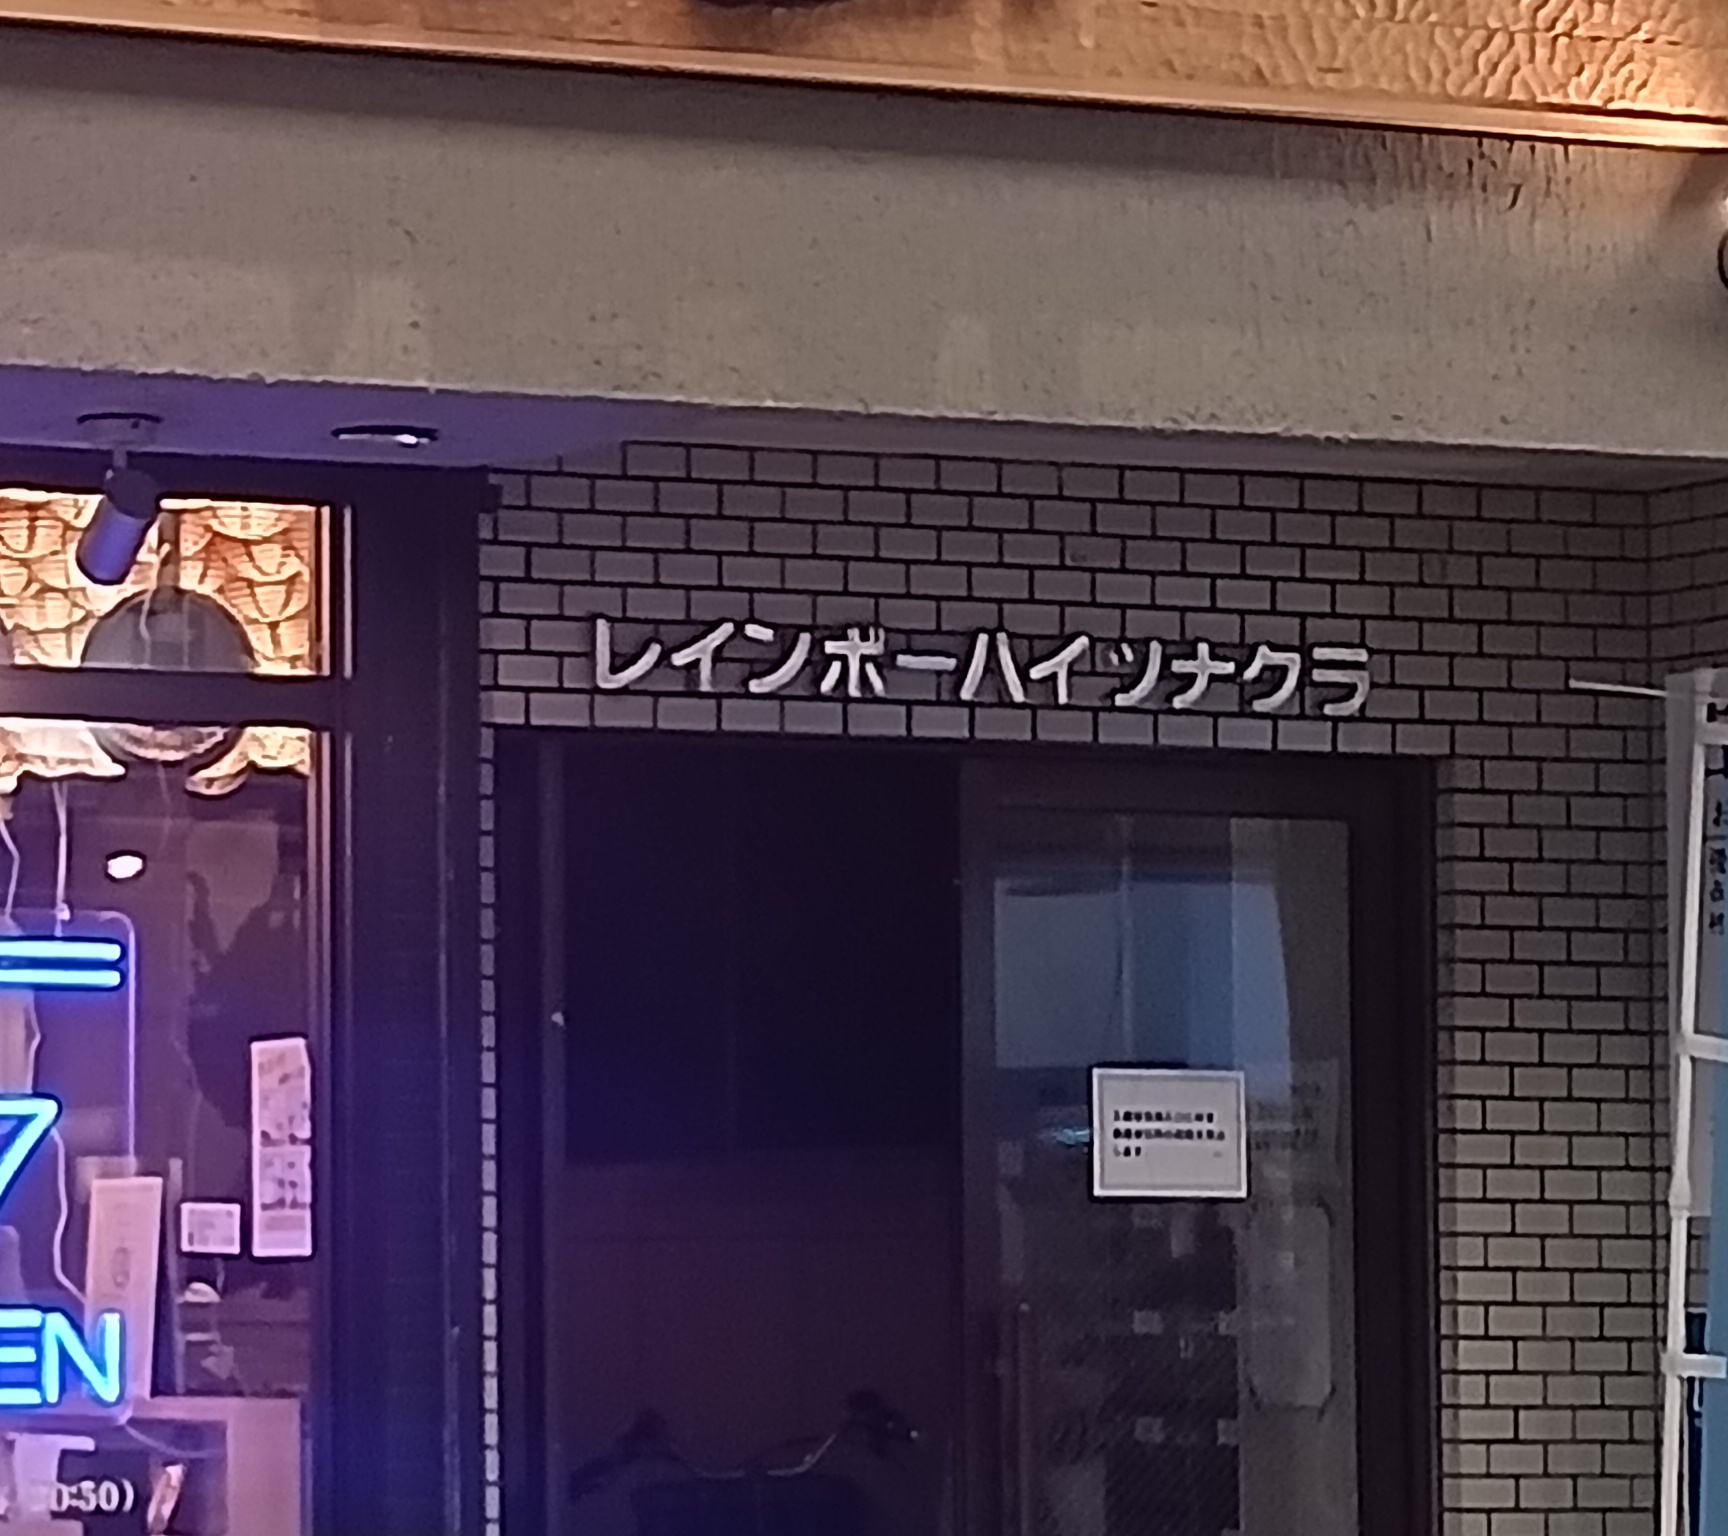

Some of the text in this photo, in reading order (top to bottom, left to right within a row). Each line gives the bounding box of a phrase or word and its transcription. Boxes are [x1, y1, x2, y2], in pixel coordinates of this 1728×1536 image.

[596, 618, 1371, 717] レインボーハイツナクラ
